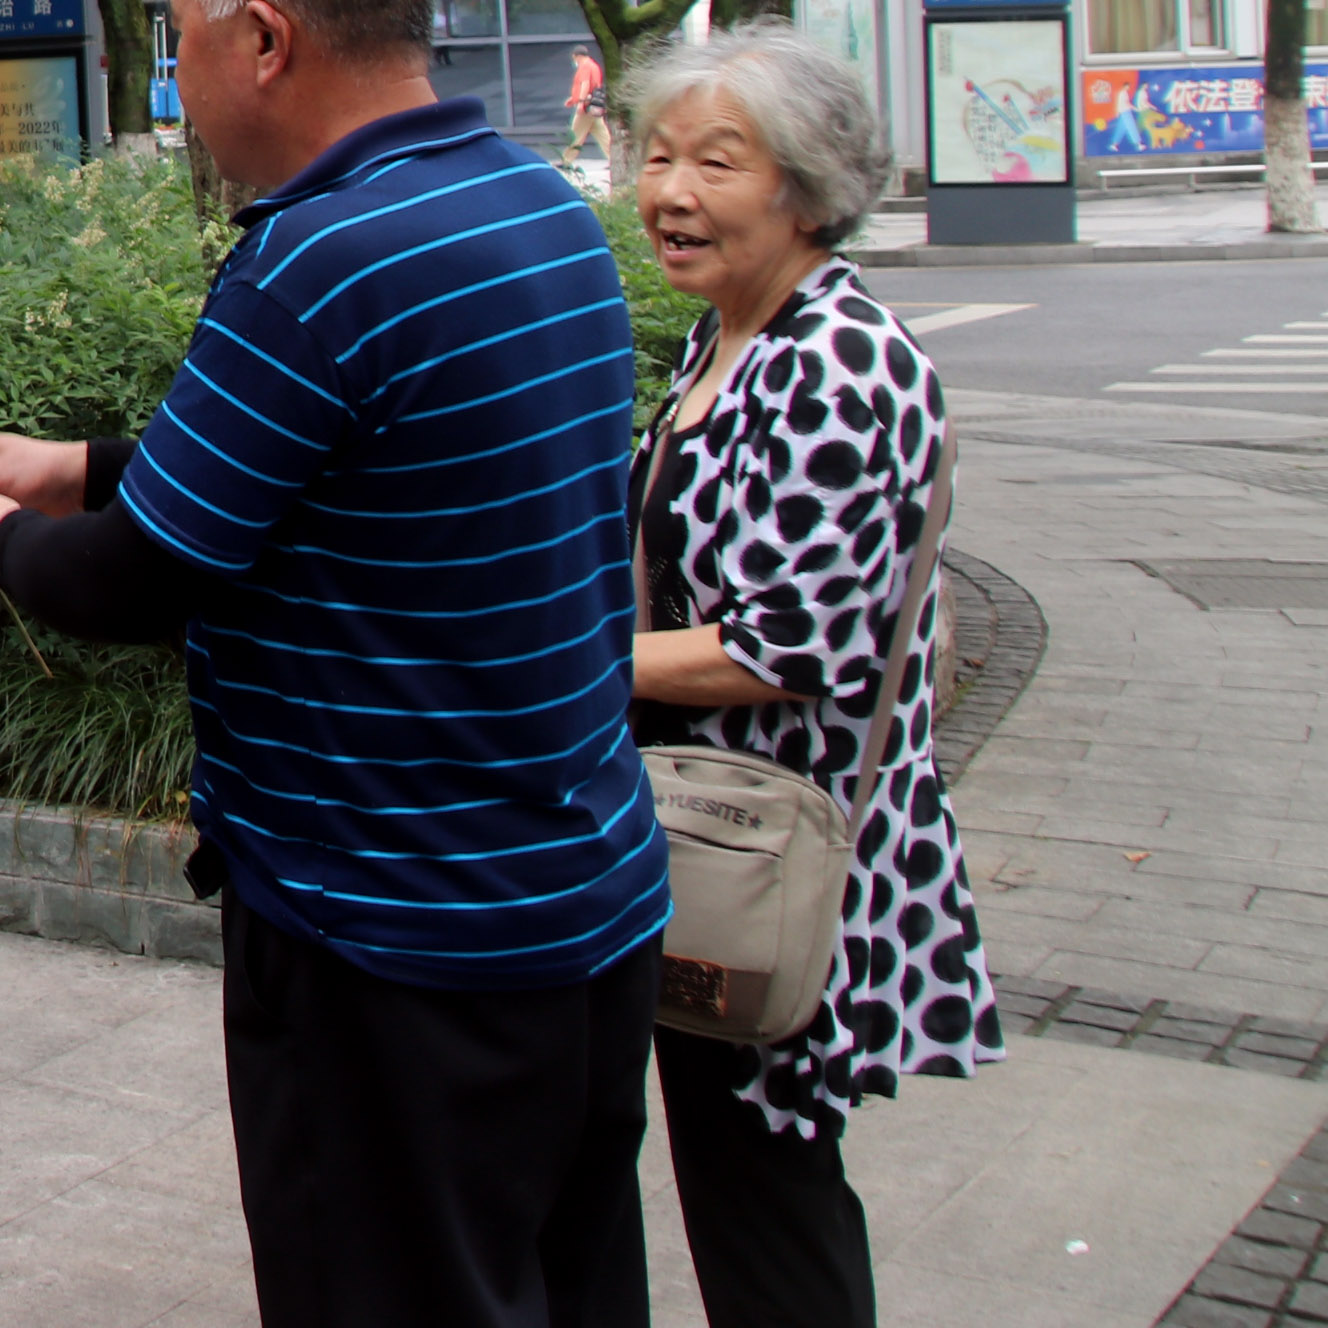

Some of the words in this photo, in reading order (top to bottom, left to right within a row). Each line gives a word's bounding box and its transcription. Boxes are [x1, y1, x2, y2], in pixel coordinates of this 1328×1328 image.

[1165, 78, 1264, 114] 依法登
[667, 793, 749, 827] YUESITE
